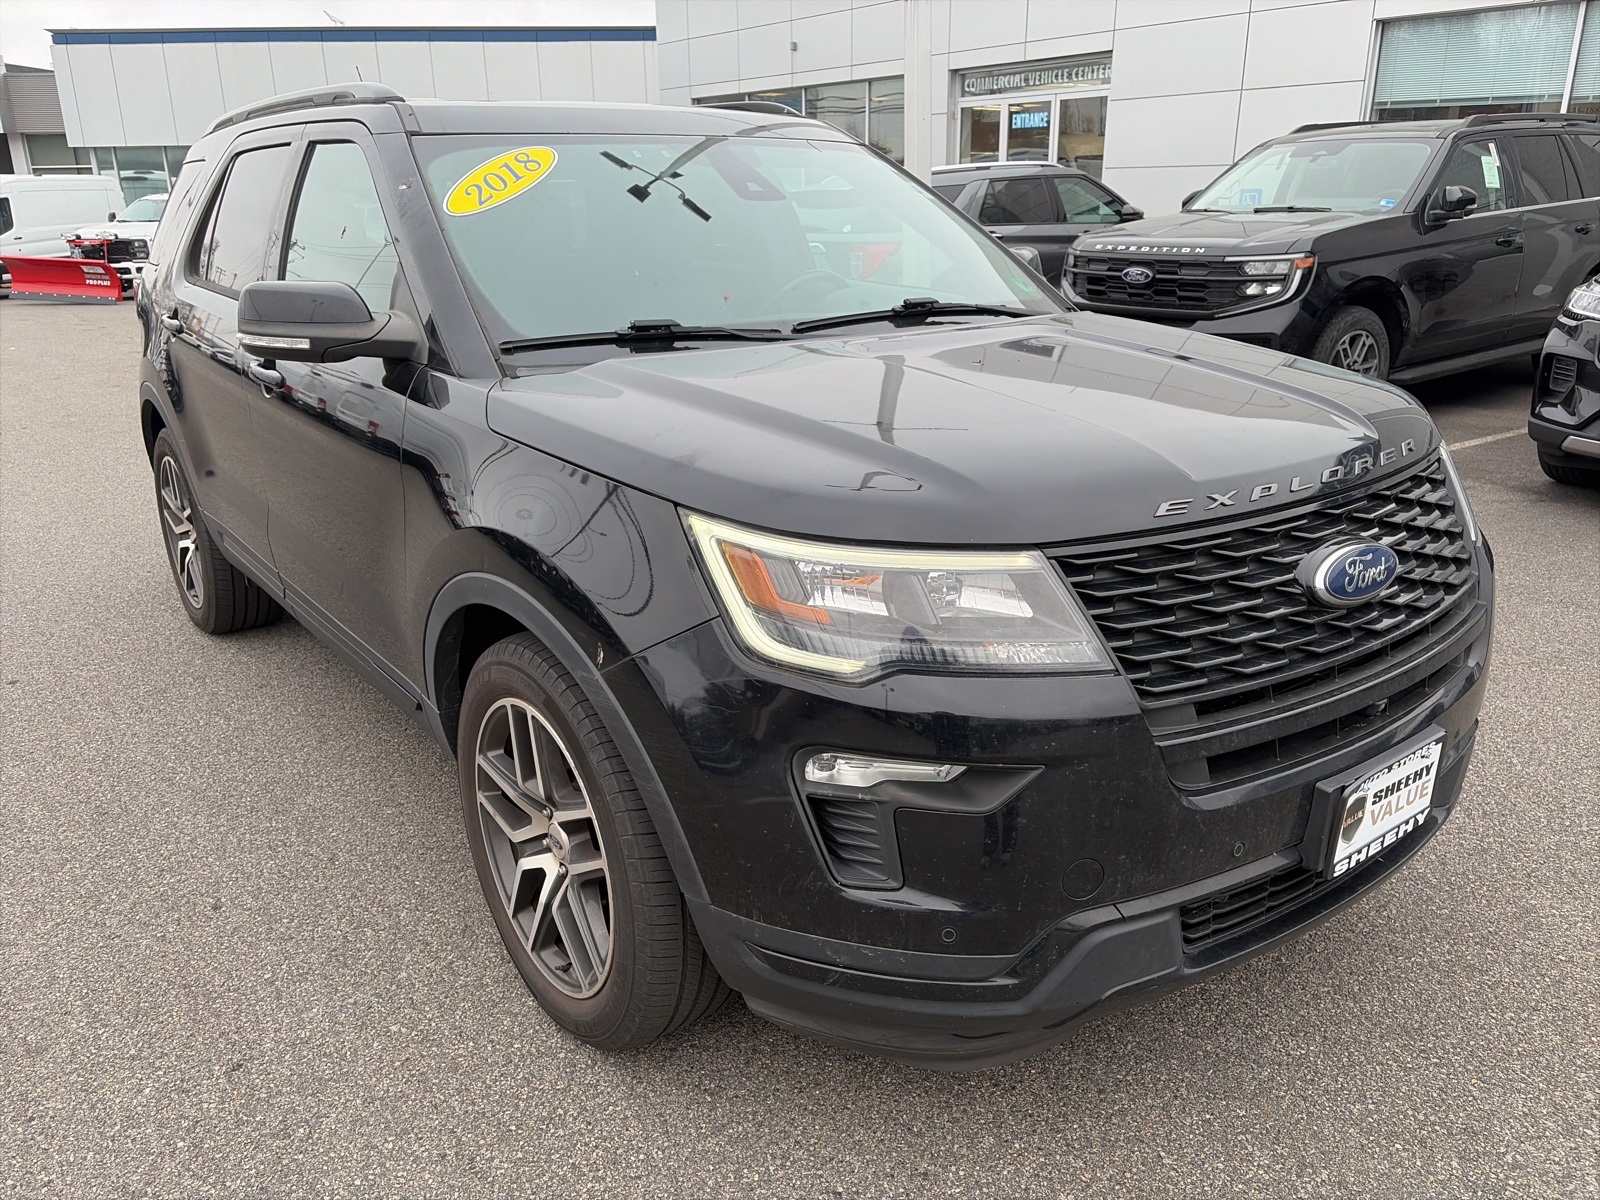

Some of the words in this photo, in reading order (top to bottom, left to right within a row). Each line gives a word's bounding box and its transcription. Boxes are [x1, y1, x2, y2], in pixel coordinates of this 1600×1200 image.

[964, 75, 1027, 92] COMMERCIAL
[1028, 68, 1068, 85] VEHICLE
[1072, 64, 1112, 81] CENTER
[1012, 112, 1048, 129] ENTRANCE
[464, 152, 542, 206] 2018
[1095, 244, 1206, 254] EXPEDITION
[1126, 269, 1148, 282] Ford
[1153, 438, 1416, 518] EXPLORER
[1344, 552, 1388, 593] Ford
[1370, 778, 1432, 827] VALUE
[1371, 761, 1436, 807] SHEEHY
[1333, 807, 1431, 877] SHEEHY
